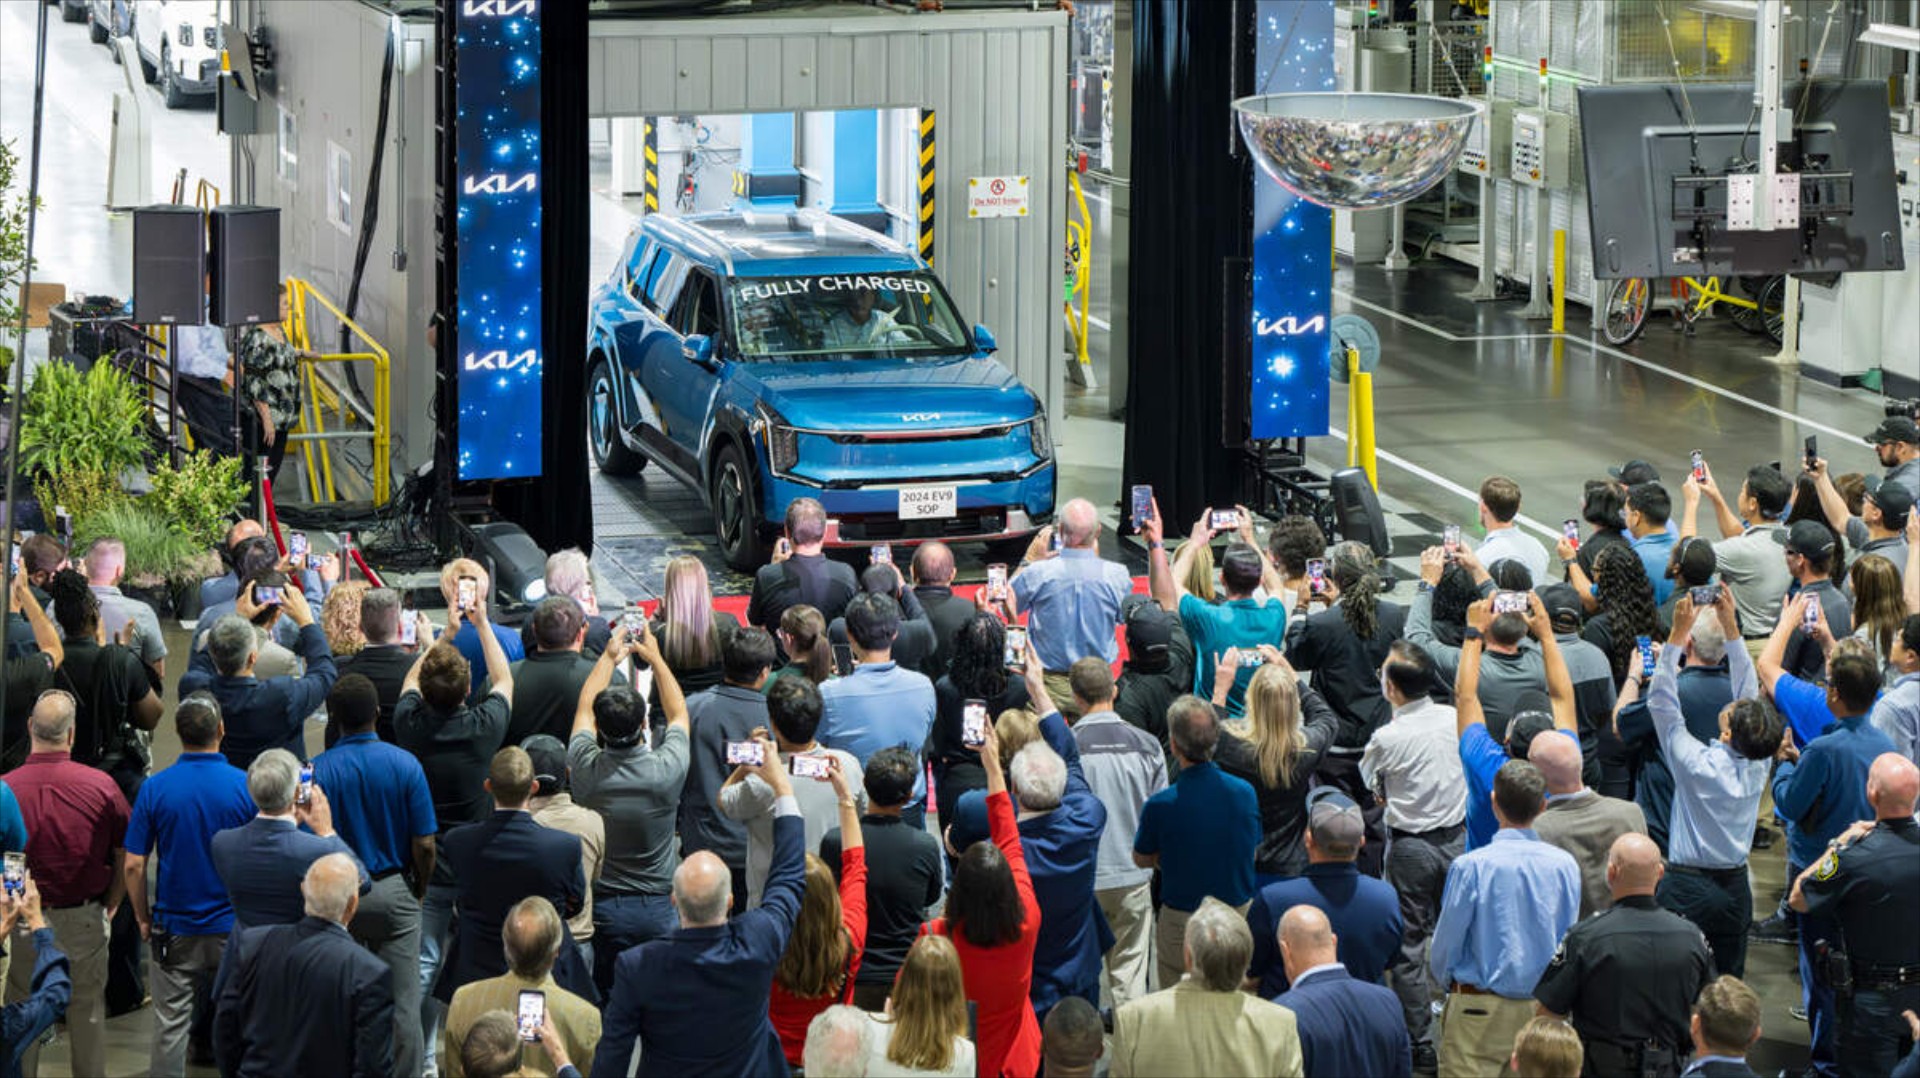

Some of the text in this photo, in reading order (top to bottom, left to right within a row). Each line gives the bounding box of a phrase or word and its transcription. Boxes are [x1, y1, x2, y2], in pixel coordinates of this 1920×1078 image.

[464, 0, 535, 16] KIA
[464, 173, 536, 194] KIA
[740, 275, 931, 301] FULLY CHARGED
[1257, 315, 1324, 335] KIA
[465, 348, 536, 370] KIA
[902, 412, 941, 422] KIA
[903, 490, 953, 503] 2024 EV9
[916, 504, 939, 514] SOP
